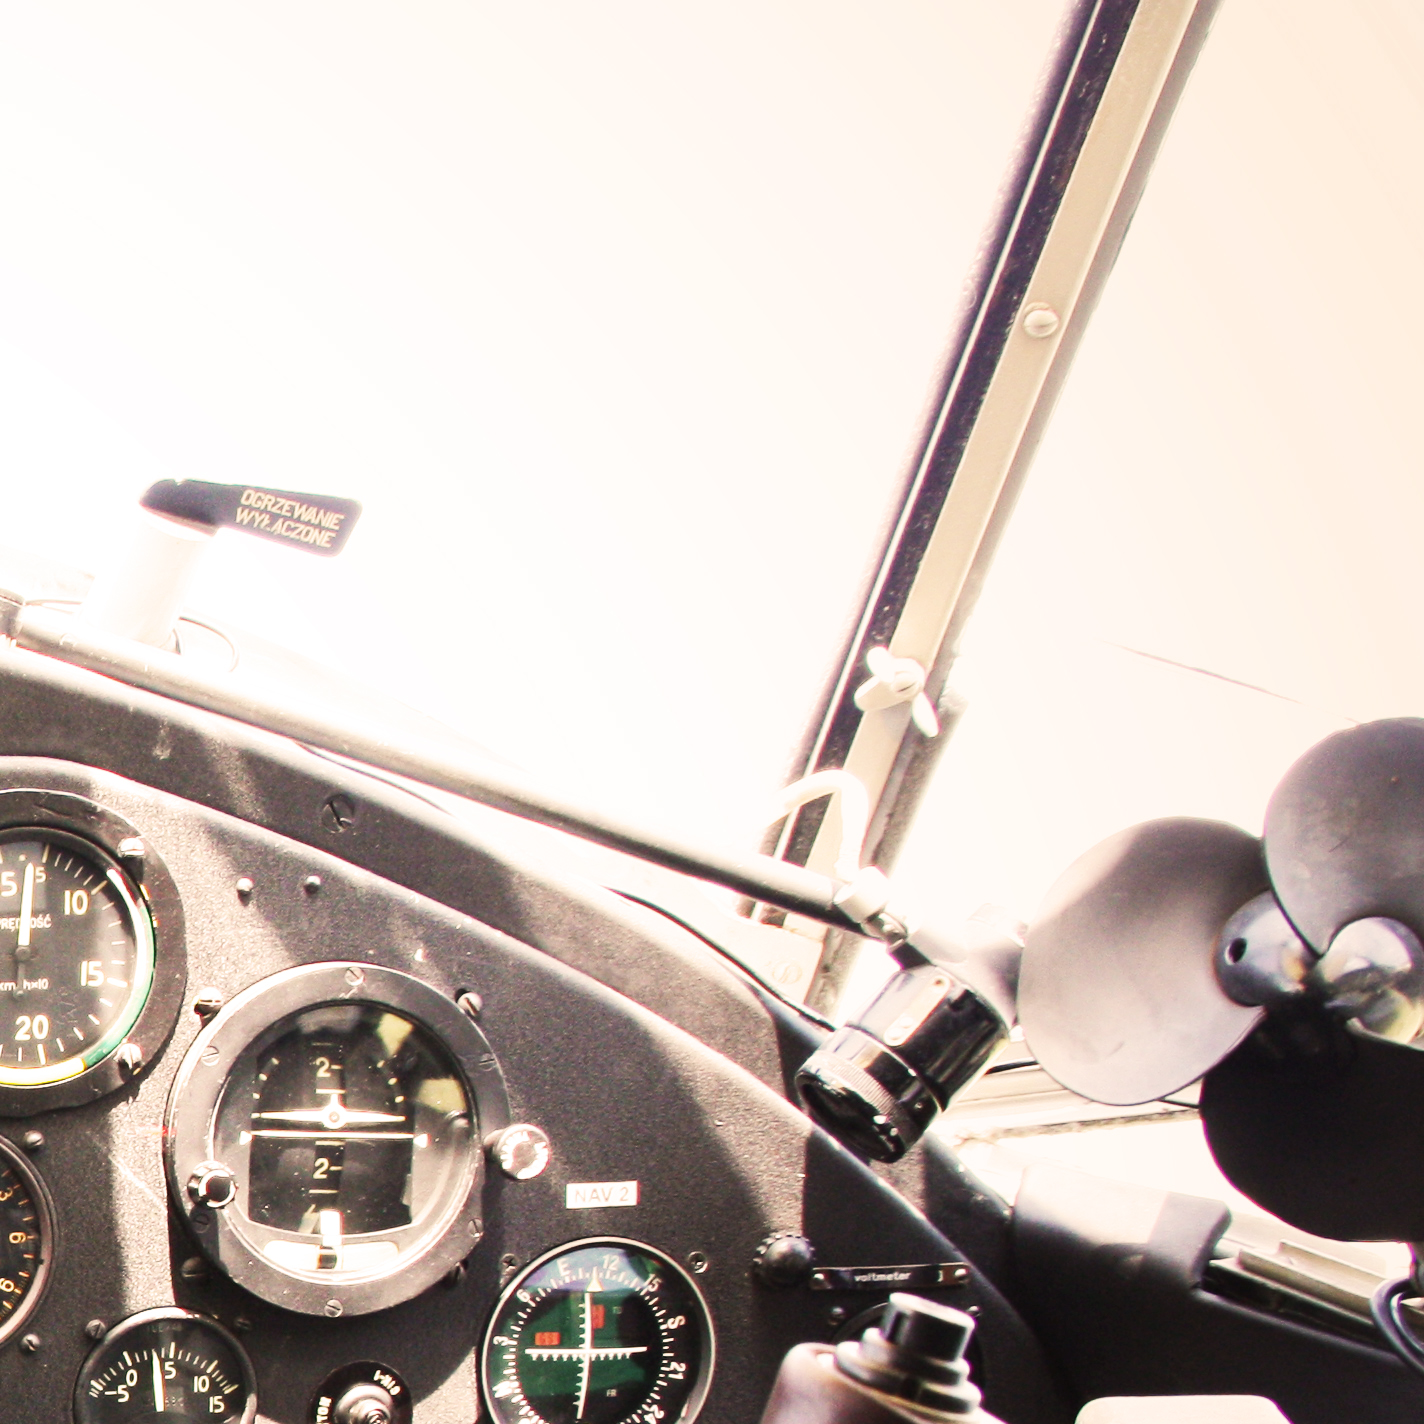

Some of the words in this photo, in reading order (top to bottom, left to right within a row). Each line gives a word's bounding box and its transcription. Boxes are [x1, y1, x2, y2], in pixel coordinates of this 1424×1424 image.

[240, 489, 345, 530] OGRZEWANIE
[64, 890, 89, 915] 10
[80, 961, 104, 986] 15
[15, 1014, 48, 1040] 20
[574, 1187, 612, 1203] NAV
[602, 1255, 619, 1270] 12
[854, 1268, 912, 1284] voltmeter
[193, 1376, 209, 1393] 10
[209, 1396, 225, 1413] 15
